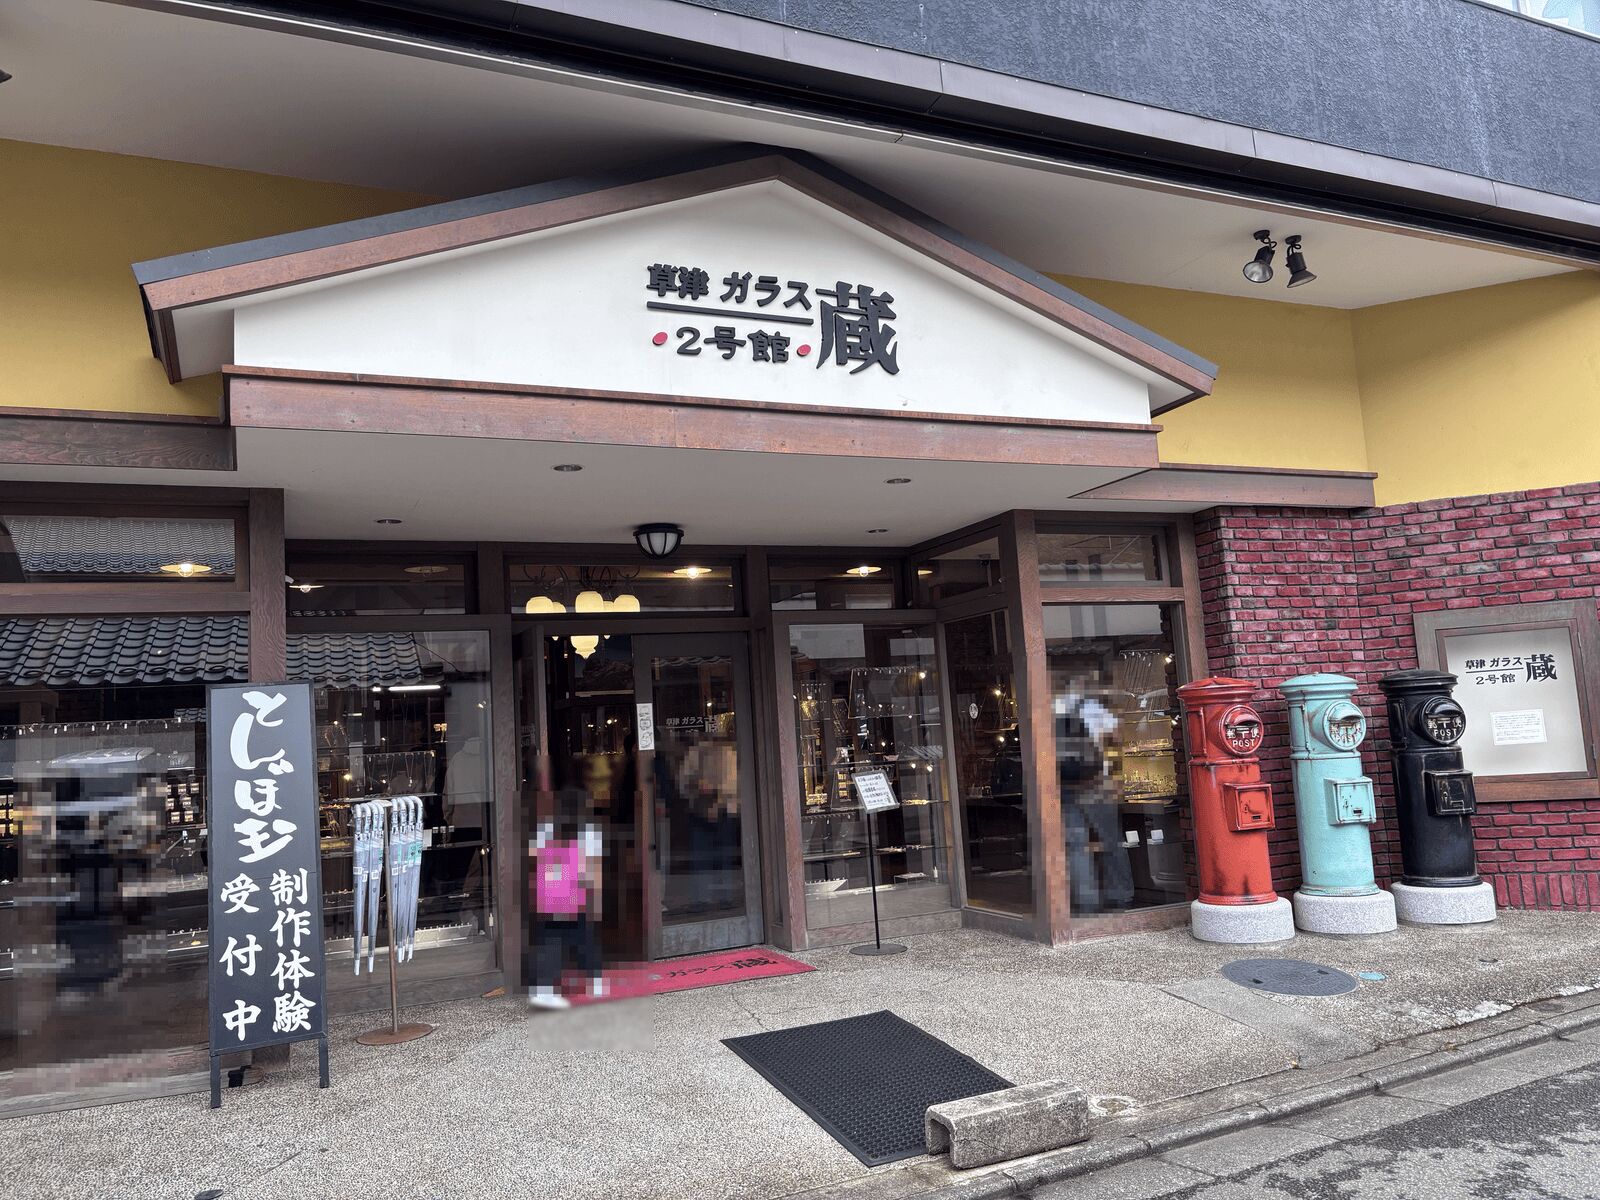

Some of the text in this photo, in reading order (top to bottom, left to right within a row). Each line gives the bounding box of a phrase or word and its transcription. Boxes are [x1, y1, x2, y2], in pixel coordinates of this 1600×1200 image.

[647, 263, 900, 374] 草津 ガラス 蔵
[676, 325, 791, 364] 2号館
[1465, 653, 1558, 683] 草津 ガラス 蔵
[1475, 673, 1516, 685] 2号館
[1232, 739, 1255, 748] POST
[1433, 728, 1457, 738] POST
[219, 873, 263, 1041] 受付中
[269, 868, 316, 1033] 制作体験
